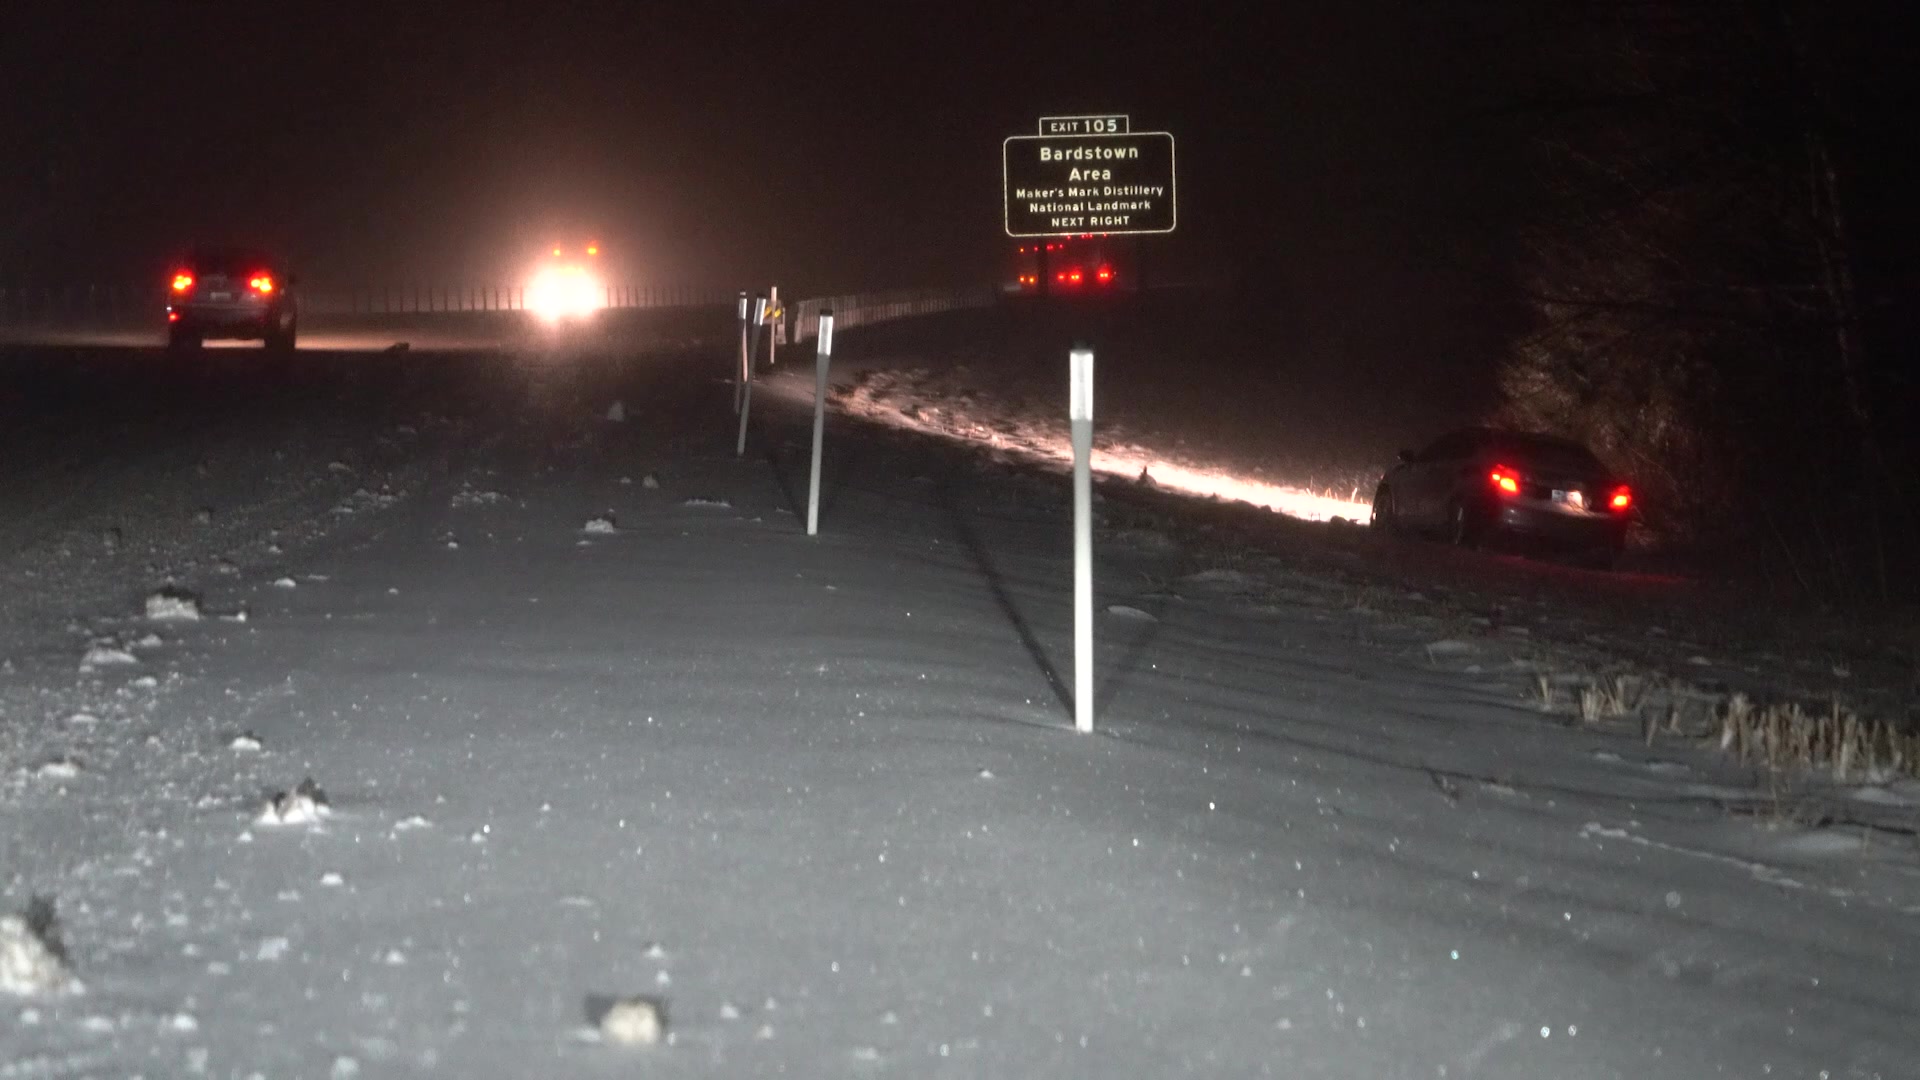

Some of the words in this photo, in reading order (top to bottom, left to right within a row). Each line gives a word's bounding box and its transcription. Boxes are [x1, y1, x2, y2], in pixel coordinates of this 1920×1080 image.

[1051, 122, 1078, 132] EXIT
[1084, 119, 1117, 133] 105
[1040, 146, 1139, 161] Bardstown
[1068, 167, 1111, 181] Area
[1016, 188, 1064, 199] Maker's
[1068, 187, 1099, 197] Mark
[1104, 185, 1164, 196] Distillery
[1029, 201, 1084, 213] National
[1088, 200, 1151, 211] Landmark
[1052, 217, 1084, 227] NEXT
[1090, 215, 1130, 226] RIGHT
